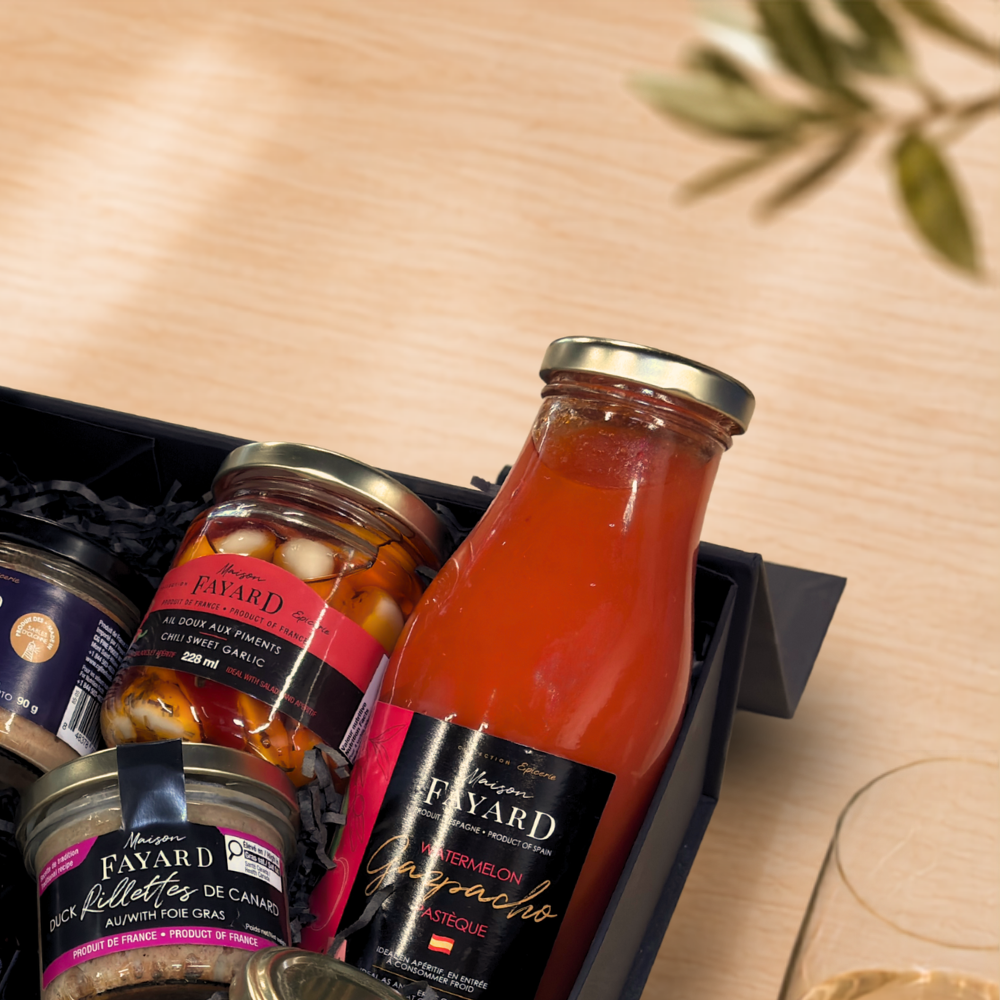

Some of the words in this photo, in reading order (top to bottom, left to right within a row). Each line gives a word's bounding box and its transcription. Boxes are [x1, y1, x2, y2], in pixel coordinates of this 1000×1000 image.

[217, 563, 266, 582] Maison
[191, 575, 284, 615] FAYARD
[162, 616, 175, 625] AIL
[178, 617, 207, 628] DOUX
[209, 623, 230, 636] AUX
[234, 629, 282, 655] PIMENTS
[194, 600, 220, 611] FRANCE
[230, 607, 264, 624] PRODUCT
[267, 620, 277, 629] OF
[279, 625, 308, 644] FRANCE
[161, 633, 184, 642] CHILI
[186, 634, 220, 650] SWEET
[222, 645, 266, 668] GARLIC
[180, 651, 202, 665] 228
[202, 657, 220, 670] ml
[17, 697, 30, 708] 90
[30, 705, 38, 715] g
[341, 730, 353, 750] Valeur
[465, 768, 534, 799] Maison
[423, 776, 556, 841] FAYARD
[123, 831, 187, 850] Maison
[487, 830, 521, 846] PRODUCT
[522, 842, 532, 850] OF
[533, 845, 552, 856] SPAIN
[57, 849, 79, 864] tradition
[58, 860, 74, 874] recipe
[100, 846, 214, 881] FAYARD
[421, 841, 523, 885] WATERMELON
[364, 833, 558, 923] Gazpacho
[50, 905, 77, 933] DUCK
[80, 871, 199, 921] Rillettes
[204, 885, 225, 899] DE
[228, 887, 279, 917] CANARD
[105, 910, 157, 929] AU/WITH
[161, 908, 189, 919] FOIE
[192, 908, 226, 921] GRAS
[415, 905, 488, 938] PASTÈQUE
[73, 941, 105, 959] PRODUIT
[107, 937, 119, 948] DE
[121, 931, 157, 944] FRANCE
[169, 930, 213, 940] PRODUCT
[215, 930, 227, 940] OF
[228, 931, 259, 947] FRANCE
[390, 961, 449, 985] CONSOMMER
[450, 980, 475, 994] FROID
[447, 971, 459, 980] EN
[460, 974, 489, 990] ENTRÉE
